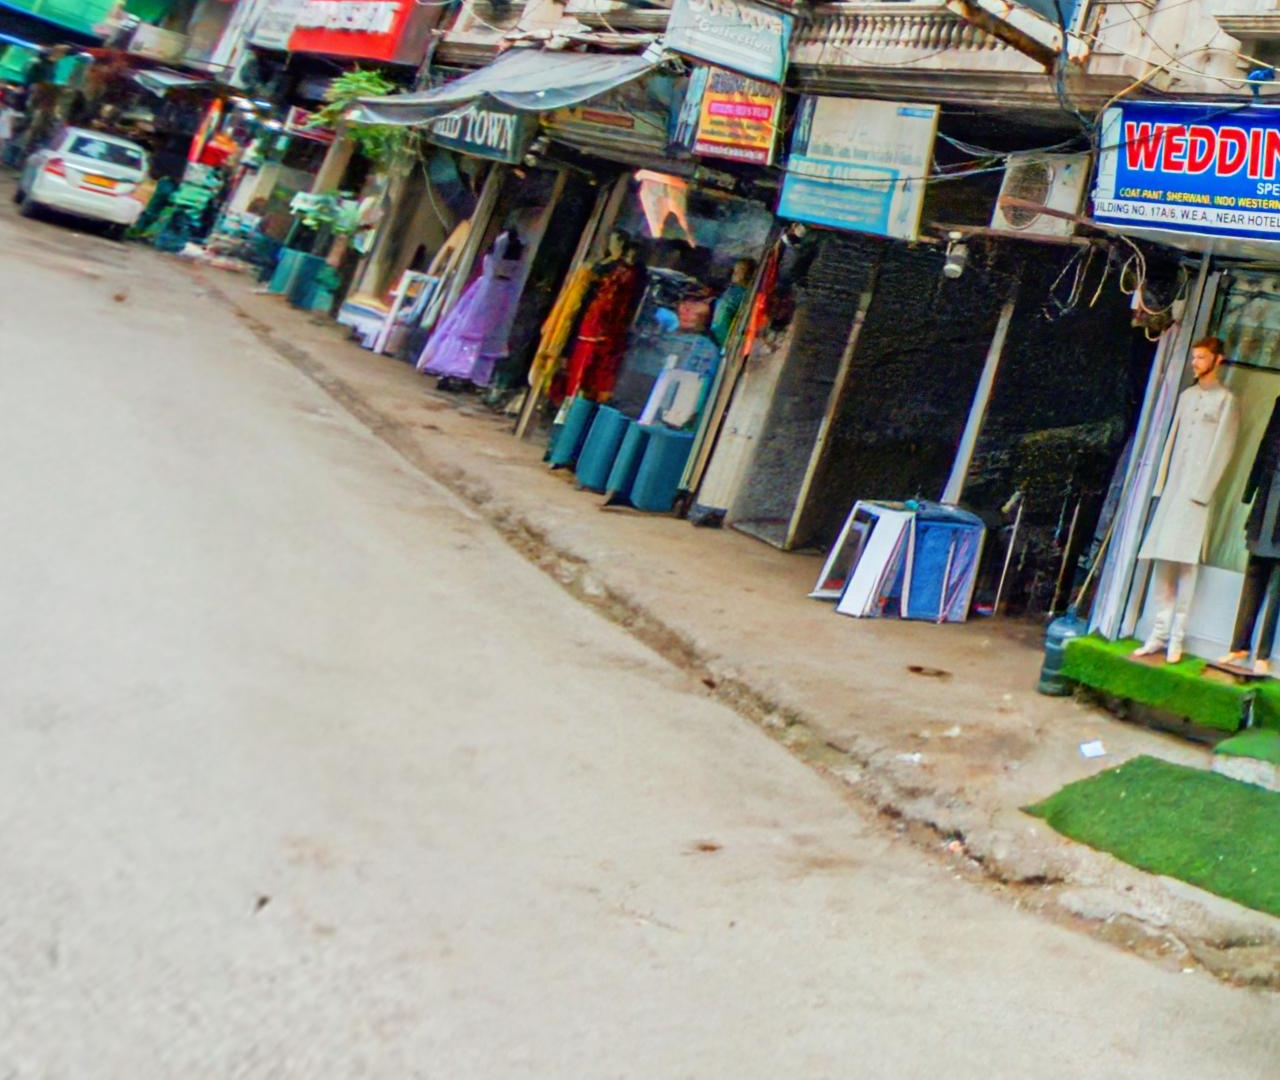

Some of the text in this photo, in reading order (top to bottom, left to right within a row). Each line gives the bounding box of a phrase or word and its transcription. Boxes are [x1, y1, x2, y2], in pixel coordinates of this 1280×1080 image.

[464, 109, 518, 154] TOWN
[1213, 195, 1237, 207] INDO
[1215, 213, 1245, 226] NEAR
